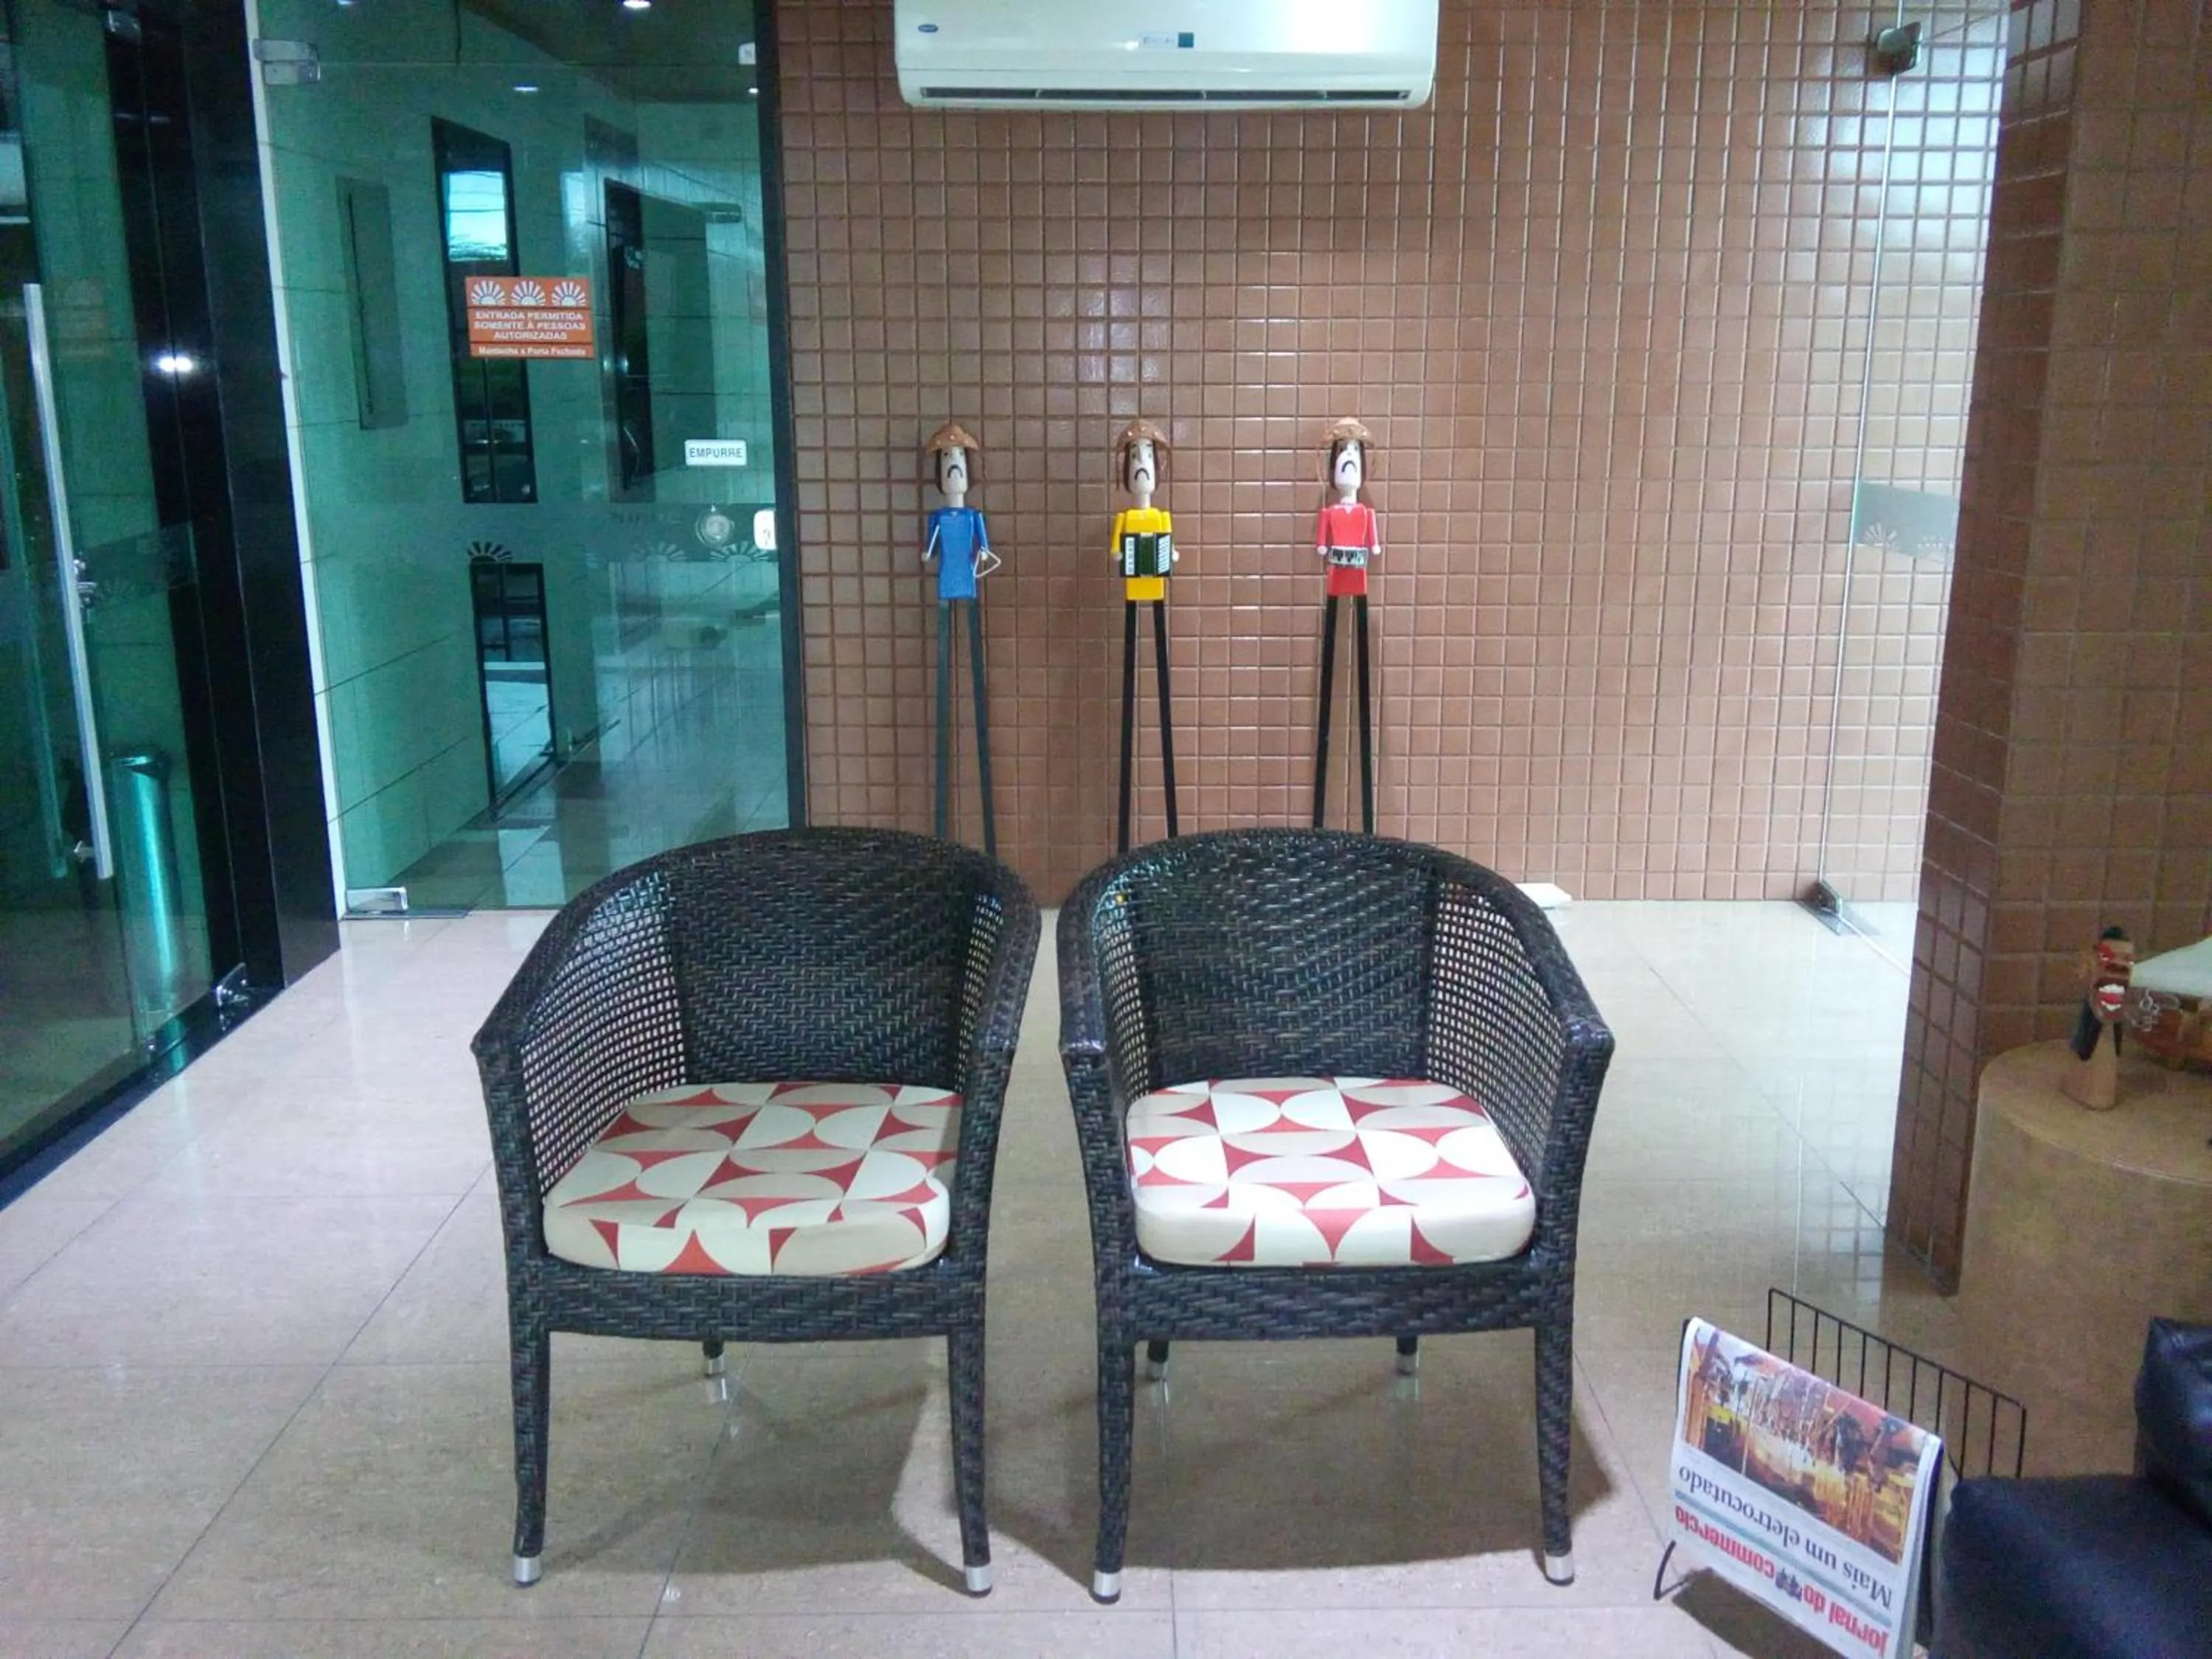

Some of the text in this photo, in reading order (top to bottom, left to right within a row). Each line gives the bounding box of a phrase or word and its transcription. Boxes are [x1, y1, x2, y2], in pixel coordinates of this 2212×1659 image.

[476, 311, 583, 320] ENTRADA PERMITIDA
[474, 321, 524, 329] SOMENTE
[537, 321, 585, 330] PESSOAS
[494, 331, 567, 340] AUTORIZADAS
[689, 448, 742, 458] EMPURRE
[1674, 1505, 1775, 1580] commercio
[1679, 1466, 1893, 1609] Mais um eletrocutado
[1804, 1585, 1826, 1613] do
